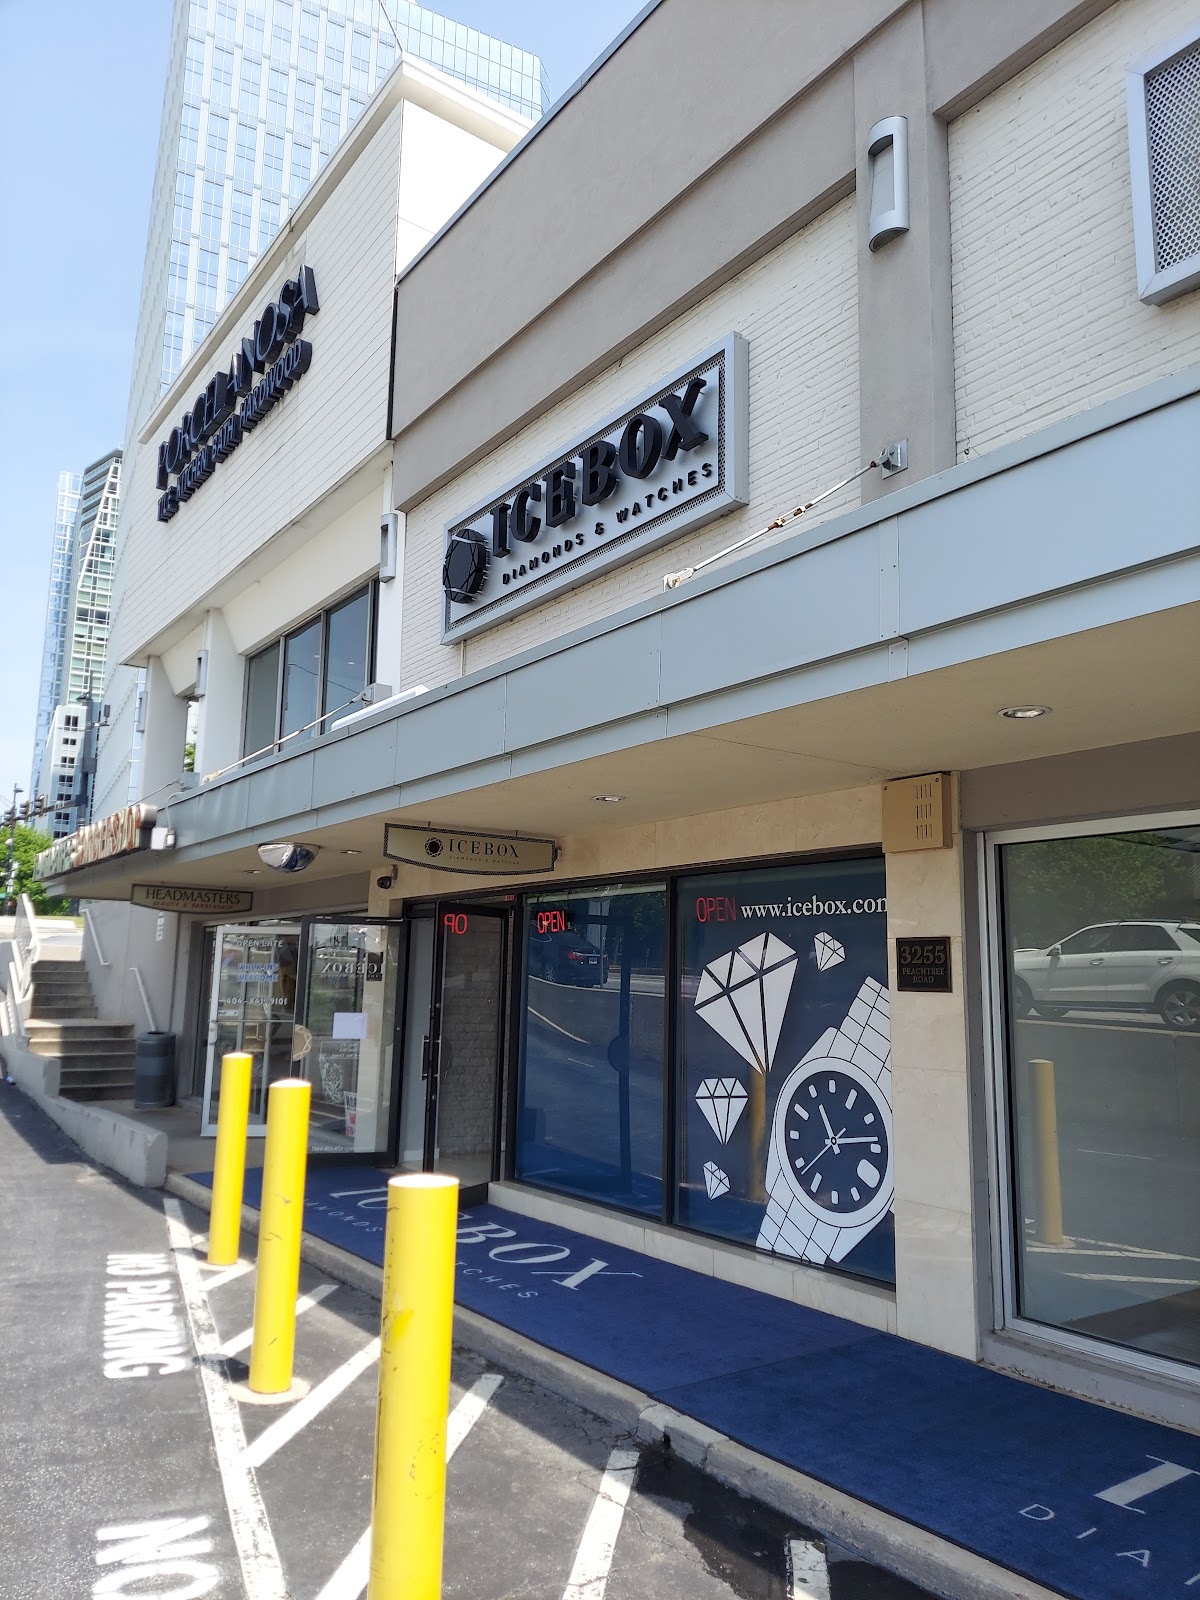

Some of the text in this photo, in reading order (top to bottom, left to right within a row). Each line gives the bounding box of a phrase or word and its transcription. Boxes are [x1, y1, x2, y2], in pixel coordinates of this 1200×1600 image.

[156, 264, 320, 490] PORCELANOSA
[177, 444, 216, 502] KITCHEN
[211, 413, 243, 464] BATH
[239, 338, 313, 433] HARDWOOD
[489, 377, 708, 558] ICEBOX
[502, 462, 713, 585] DIAMONDS & WATCHES
[449, 838, 519, 858] ICEBOX
[146, 888, 240, 905] HEADMASTERS
[695, 897, 737, 923] OPEN
[537, 910, 566, 934] OPEN
[236, 939, 284, 948] OPEN LATE
[900, 946, 946, 965] 3255
[236, 973, 280, 983] WELCOME
[237, 962, 280, 972] WALK-INS
[902, 967, 945, 977] PEACHTREE
[912, 976, 935, 985] ROAD
[103, 1253, 189, 1379] NO PARKING
[92, 1515, 220, 1600] NO
